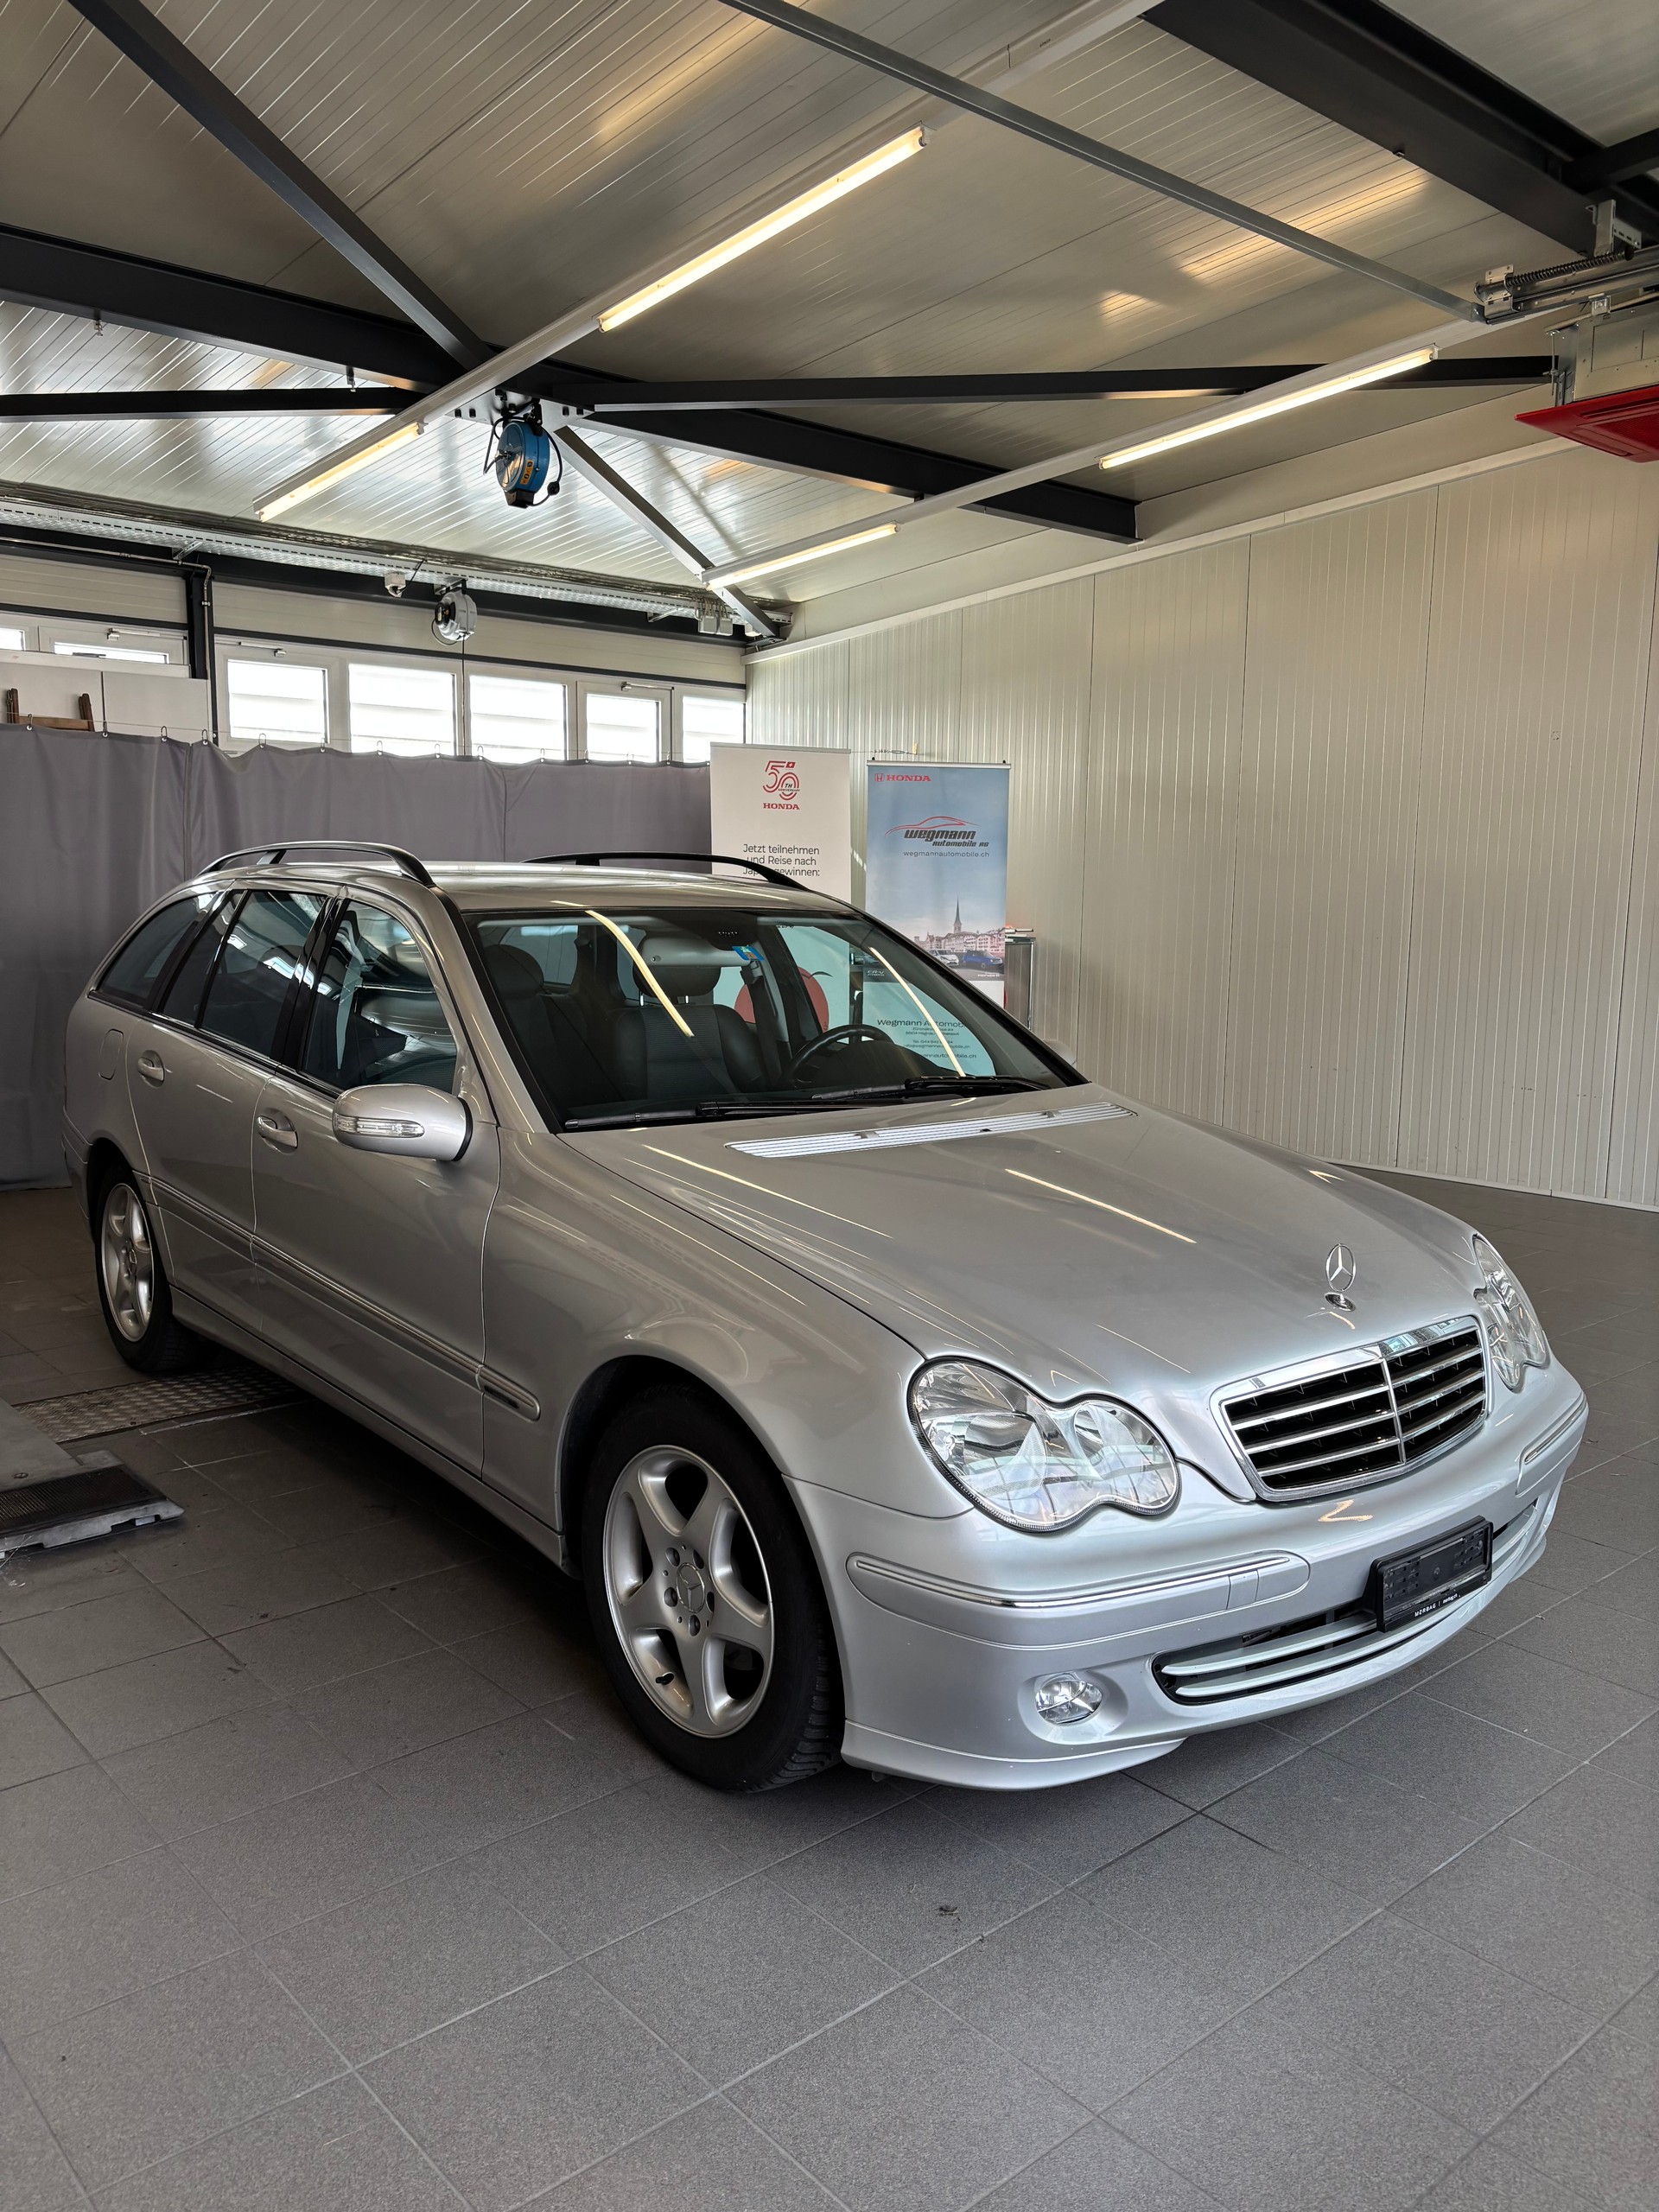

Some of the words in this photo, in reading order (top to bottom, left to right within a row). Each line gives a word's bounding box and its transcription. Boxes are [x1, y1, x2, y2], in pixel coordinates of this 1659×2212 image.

[904, 830, 976, 842] wegmann
[743, 843, 766, 854] Jetzt
[768, 845, 820, 855] teilnehmen
[767, 855, 792, 865] Reise
[794, 857, 817, 866] nach
[877, 1019, 922, 1027] Wegmann
